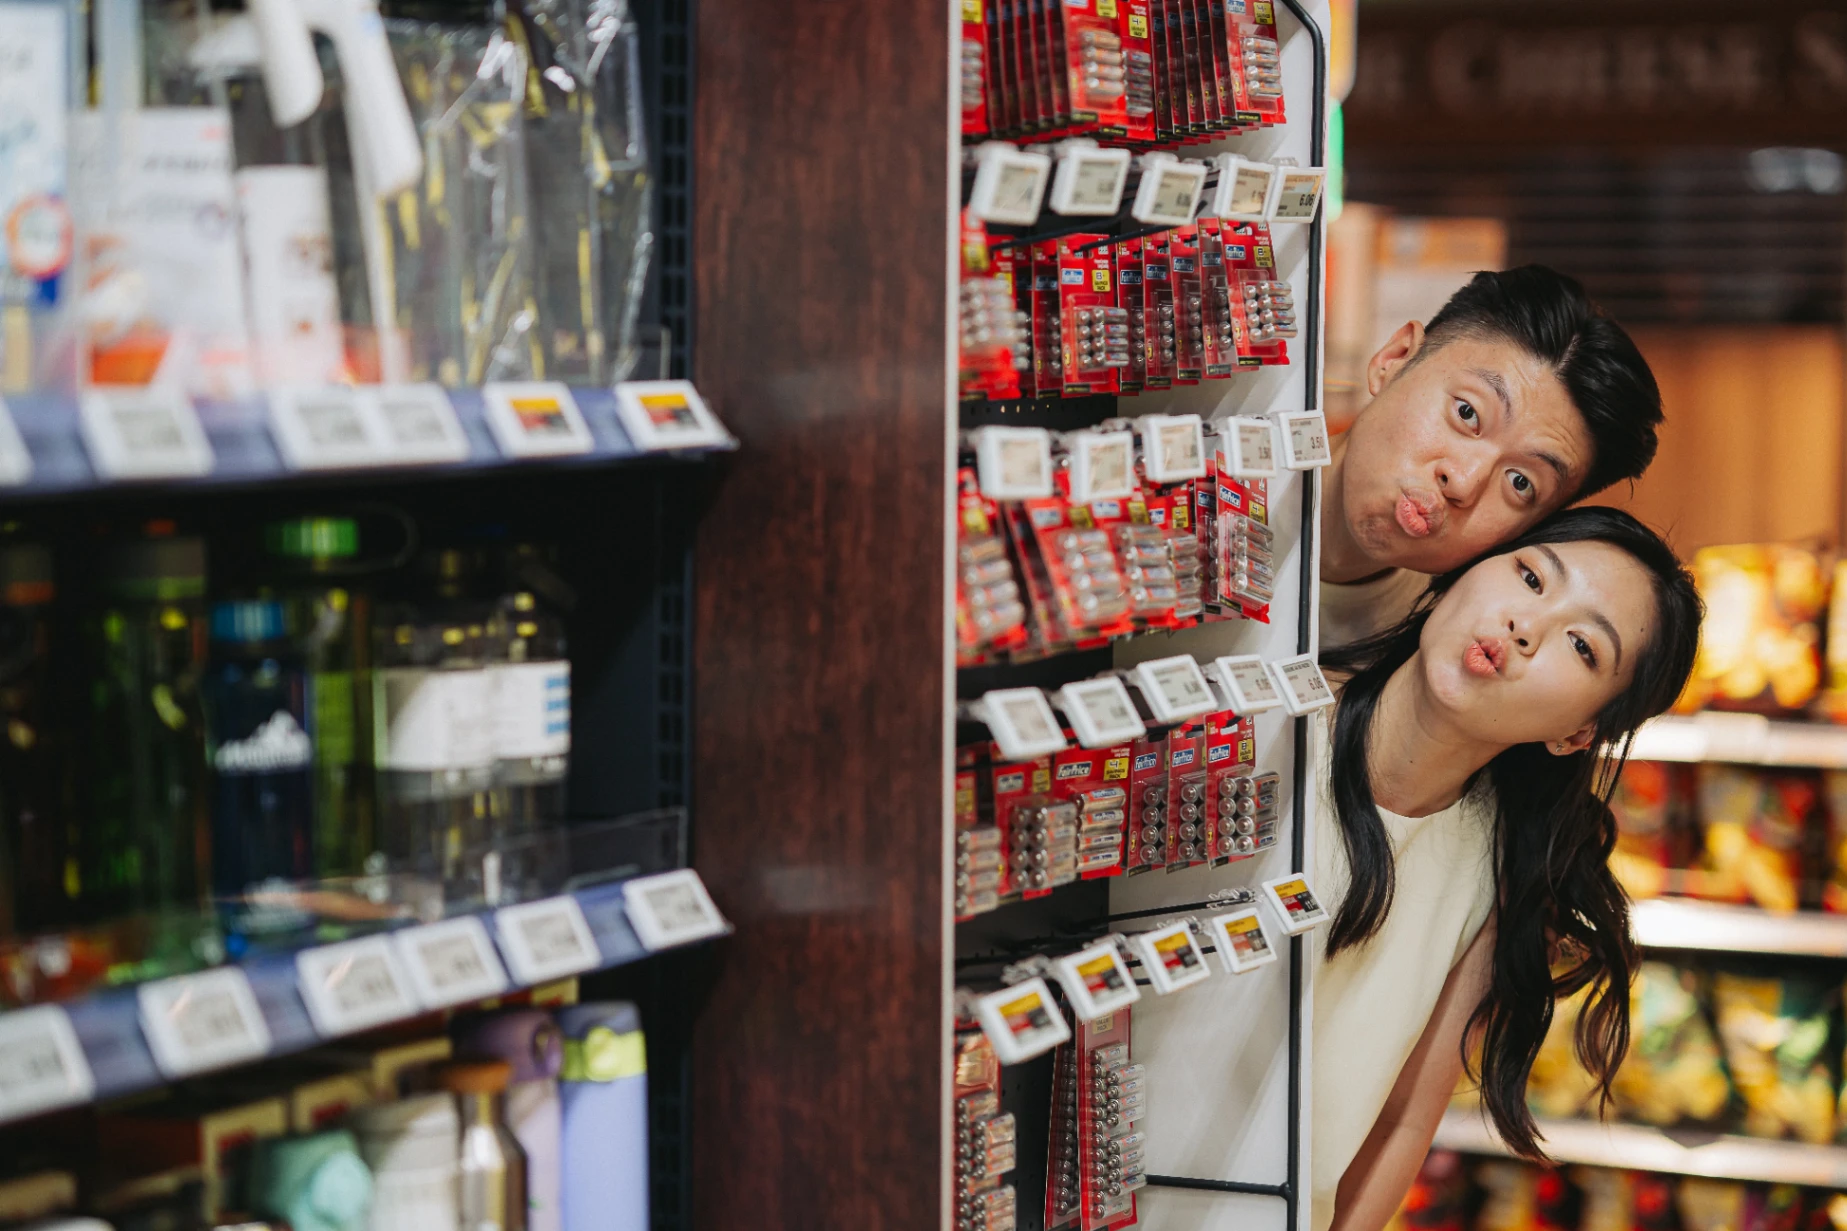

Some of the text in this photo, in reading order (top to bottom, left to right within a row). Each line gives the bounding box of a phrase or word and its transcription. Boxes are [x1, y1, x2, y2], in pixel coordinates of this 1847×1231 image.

[1299, 193, 1315, 206] 6.06
[1310, 436, 1324, 449] 3.50
[1308, 676, 1324, 691] 6.06
[1058, 764, 1090, 779] FairPrice
